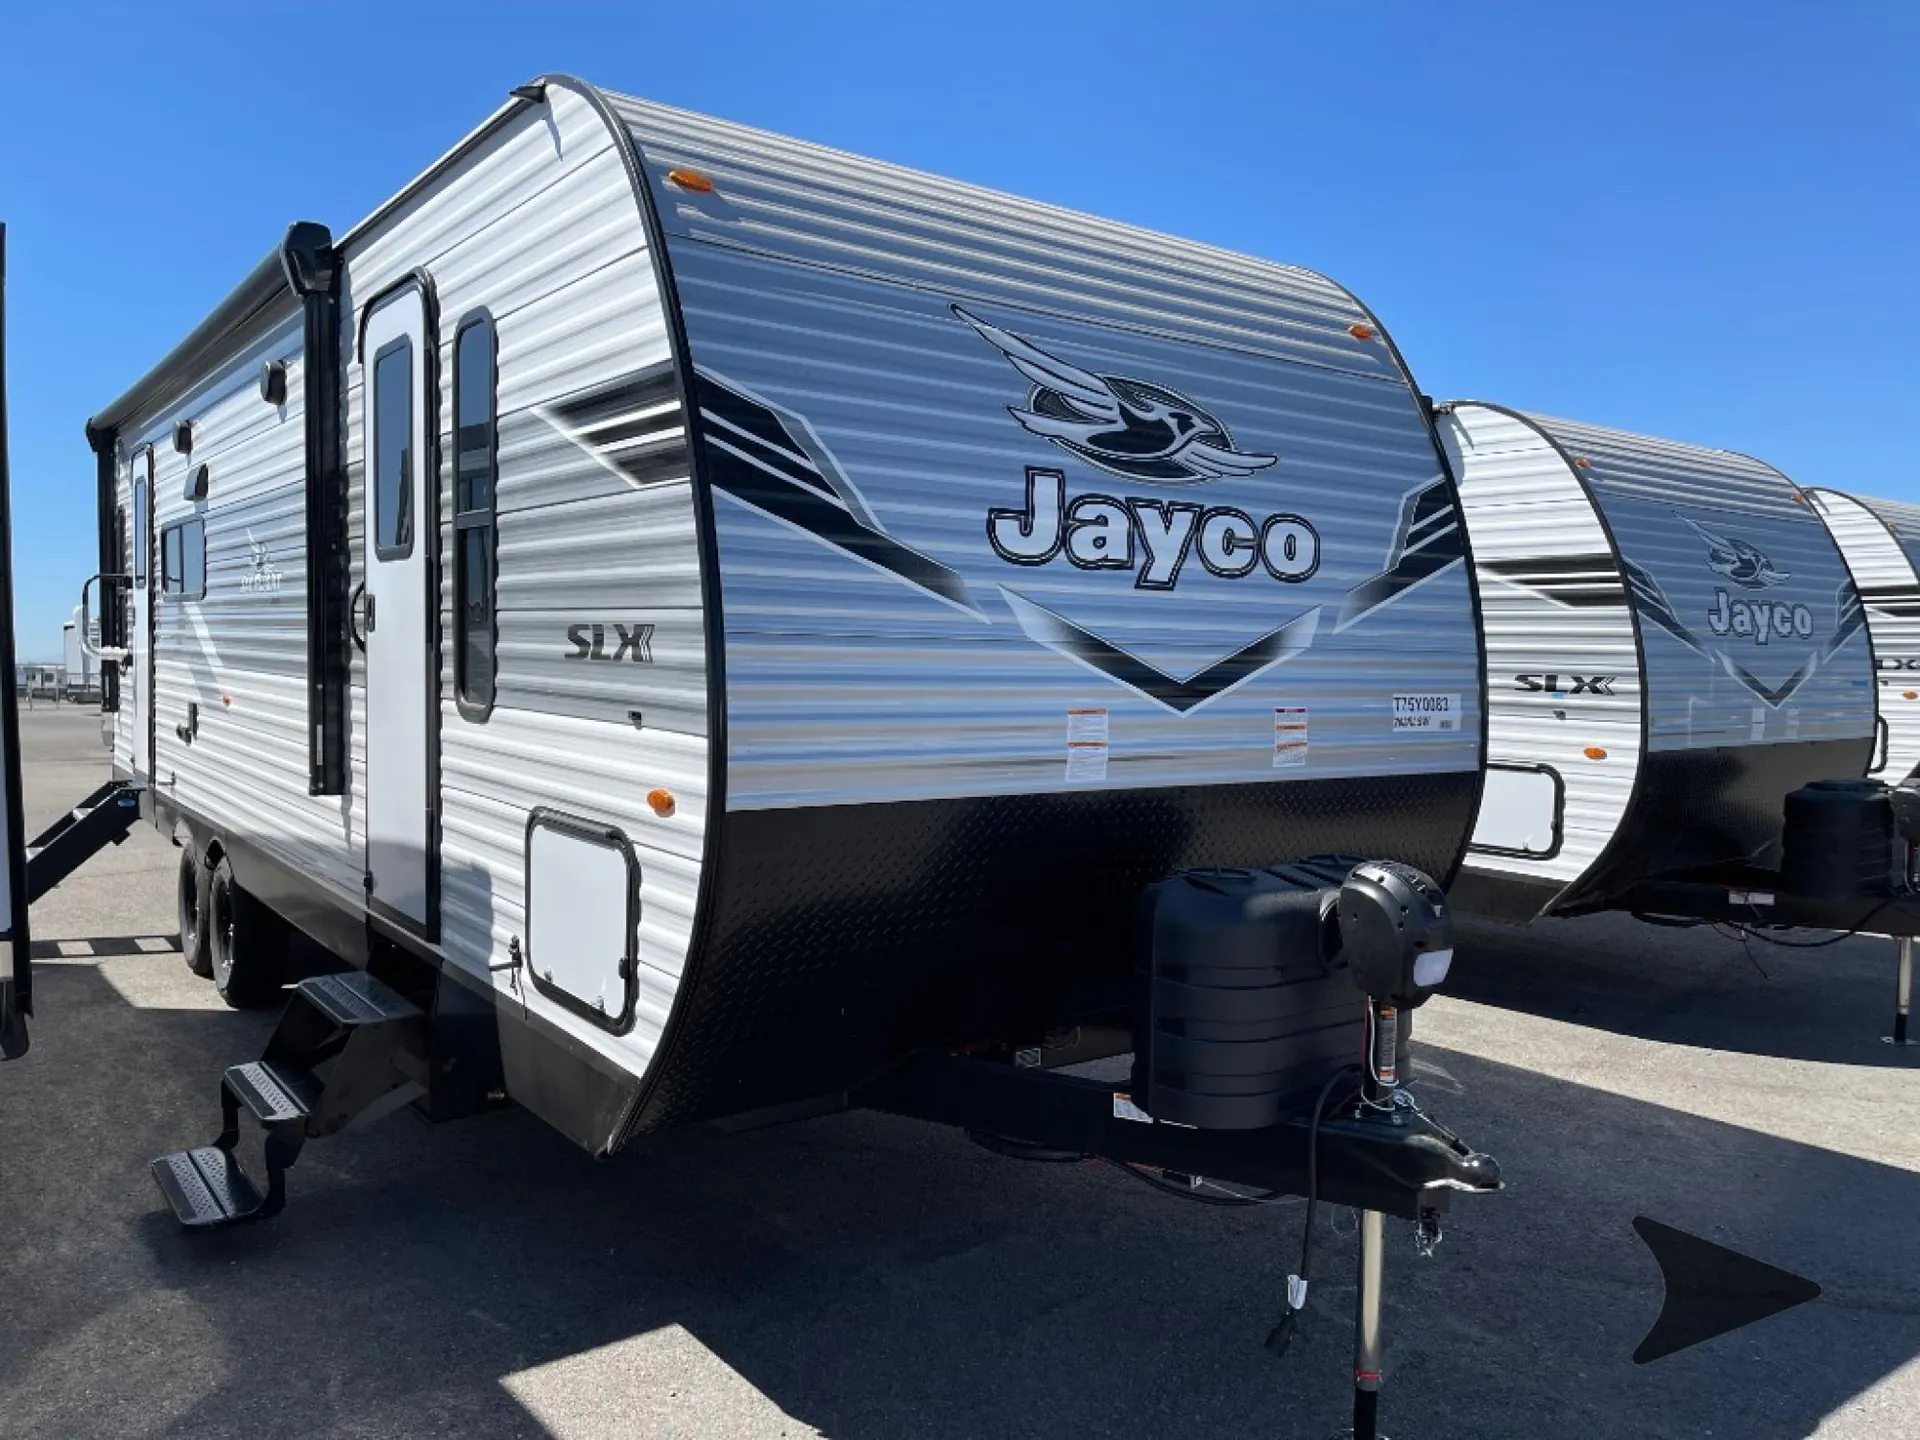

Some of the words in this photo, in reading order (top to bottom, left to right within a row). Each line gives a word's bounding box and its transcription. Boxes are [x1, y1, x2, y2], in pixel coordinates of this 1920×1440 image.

[986, 465, 1321, 591] Jayco
[1708, 586, 1813, 646] Jayco
[564, 623, 655, 663] SLX
[1875, 658, 1919, 670] LX
[1514, 674, 1616, 696] SLX
